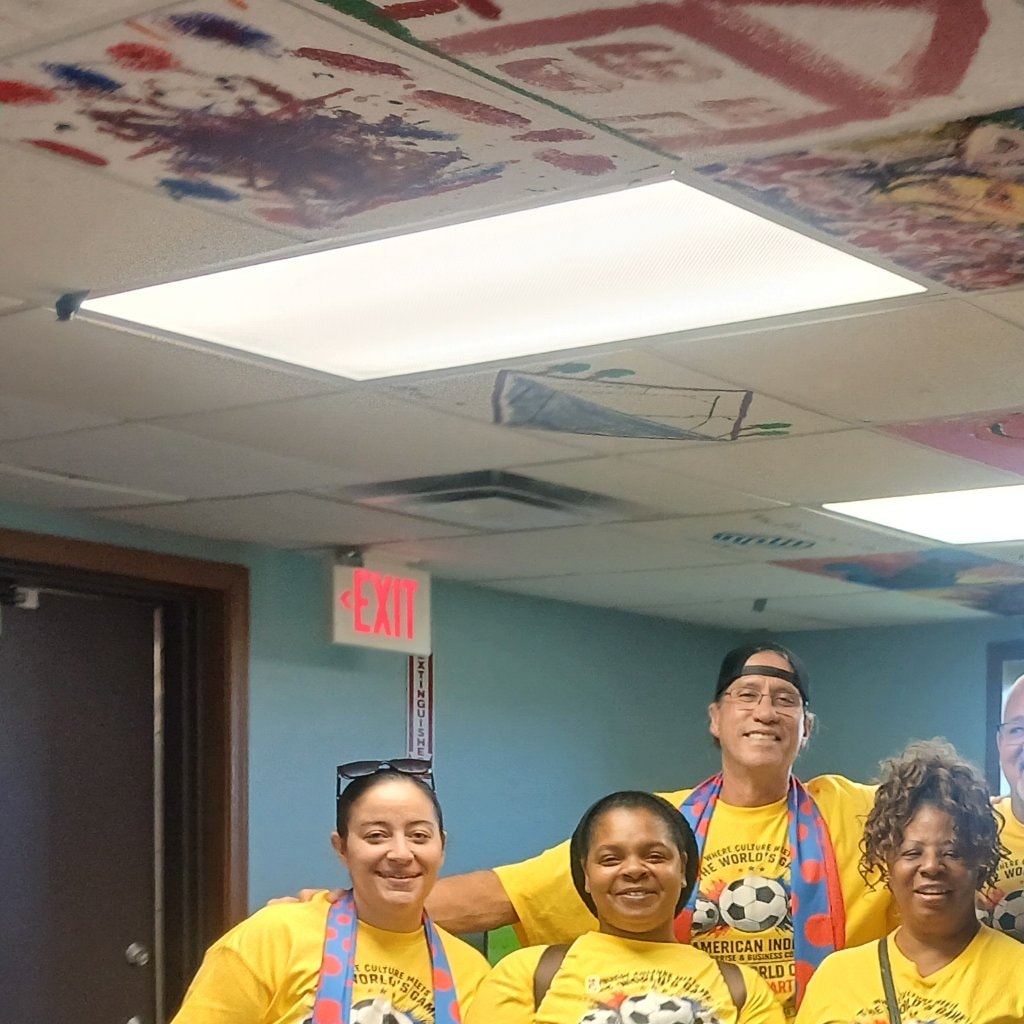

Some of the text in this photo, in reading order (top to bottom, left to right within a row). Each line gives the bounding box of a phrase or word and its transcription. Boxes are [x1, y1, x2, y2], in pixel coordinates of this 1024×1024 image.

[353, 568, 419, 640] EXIT
[417, 656, 426, 759] XTINGUISHE
[704, 844, 792, 862] WHERE CULTURE MEE
[700, 862, 718, 880] HE
[718, 852, 777, 867] WORLD'S
[692, 938, 794, 954] AMERICAN IND
[748, 952, 783, 960] BUSINESS
[364, 964, 405, 980] CULTURE
[408, 976, 432, 996] MEETS
[750, 965, 785, 979] RLD
[769, 978, 794, 994] ART
[410, 990, 436, 1014] GAM
